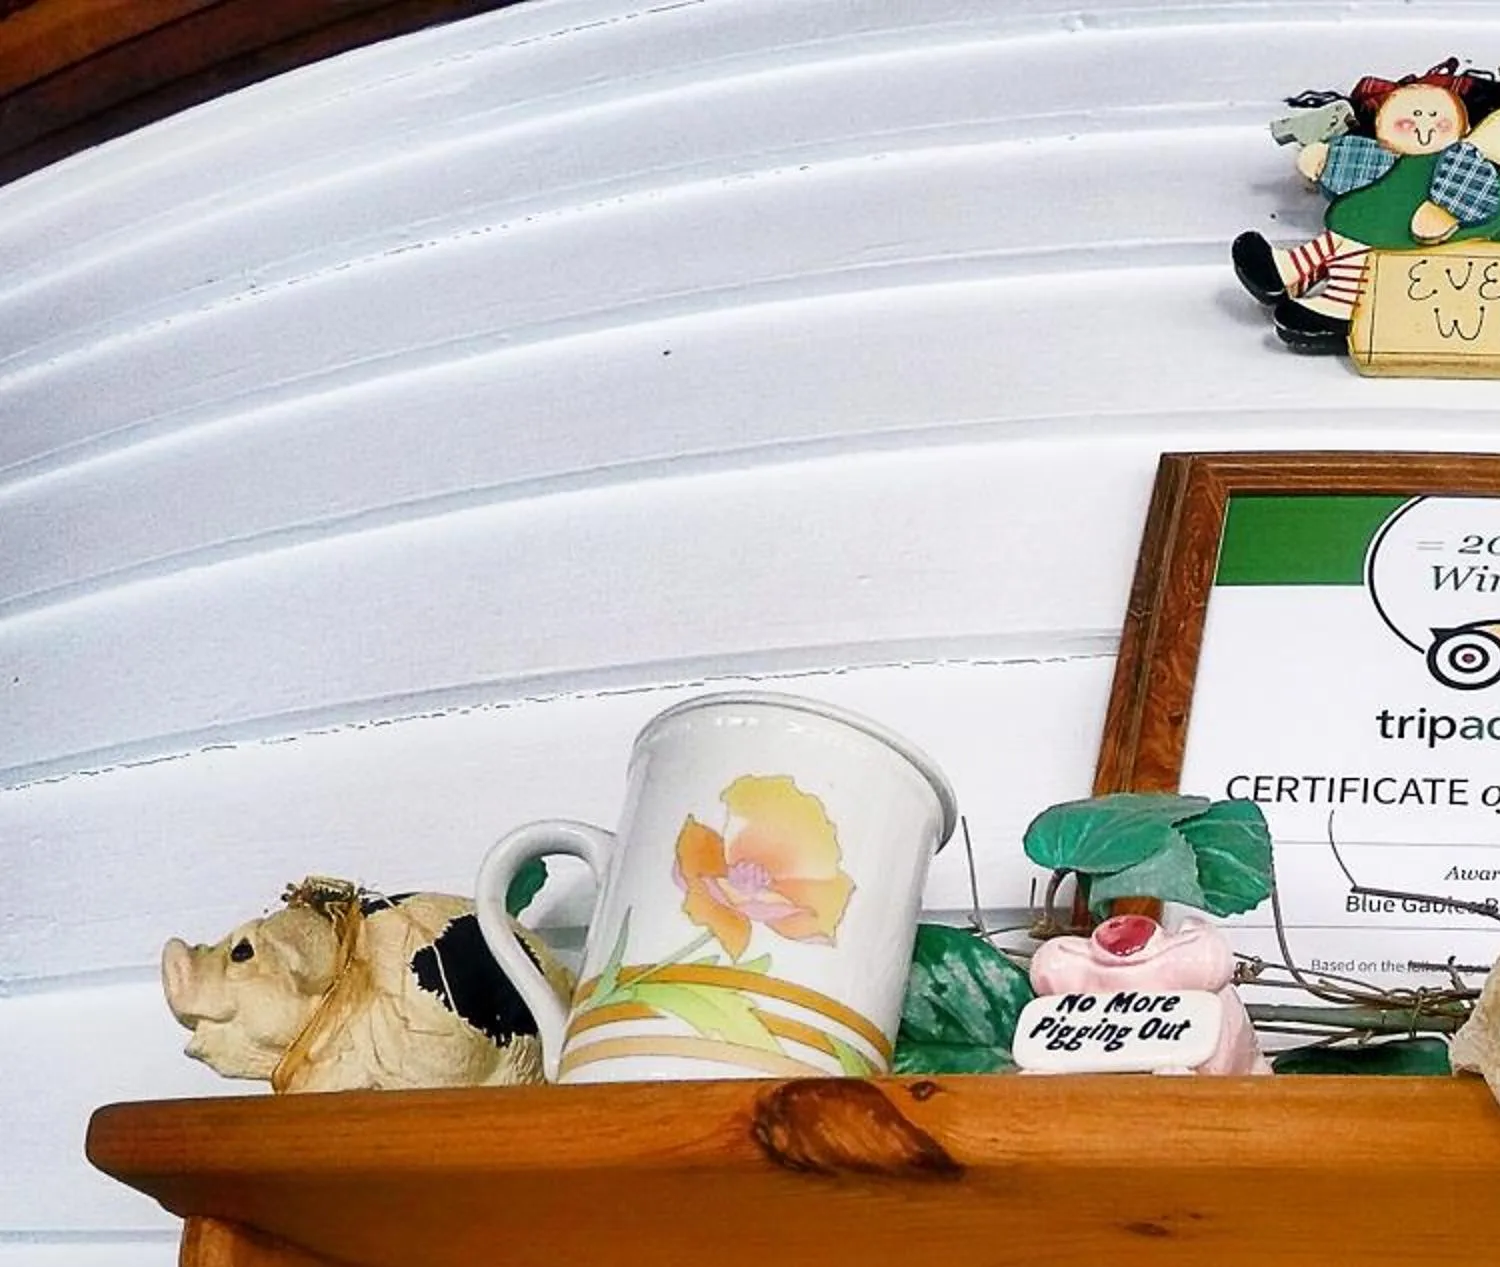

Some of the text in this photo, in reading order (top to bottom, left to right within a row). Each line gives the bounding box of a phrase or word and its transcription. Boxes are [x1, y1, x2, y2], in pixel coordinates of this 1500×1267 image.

[1225, 775, 1469, 805] CERTIFICATE
[1345, 895, 1395, 913] Blue
[1311, 959, 1355, 972] Based
[1358, 961, 1377, 972] on
[1381, 960, 1405, 973] the
[1055, 991, 1181, 1014] No More
[1029, 1016, 1192, 1053] Pigging Out
